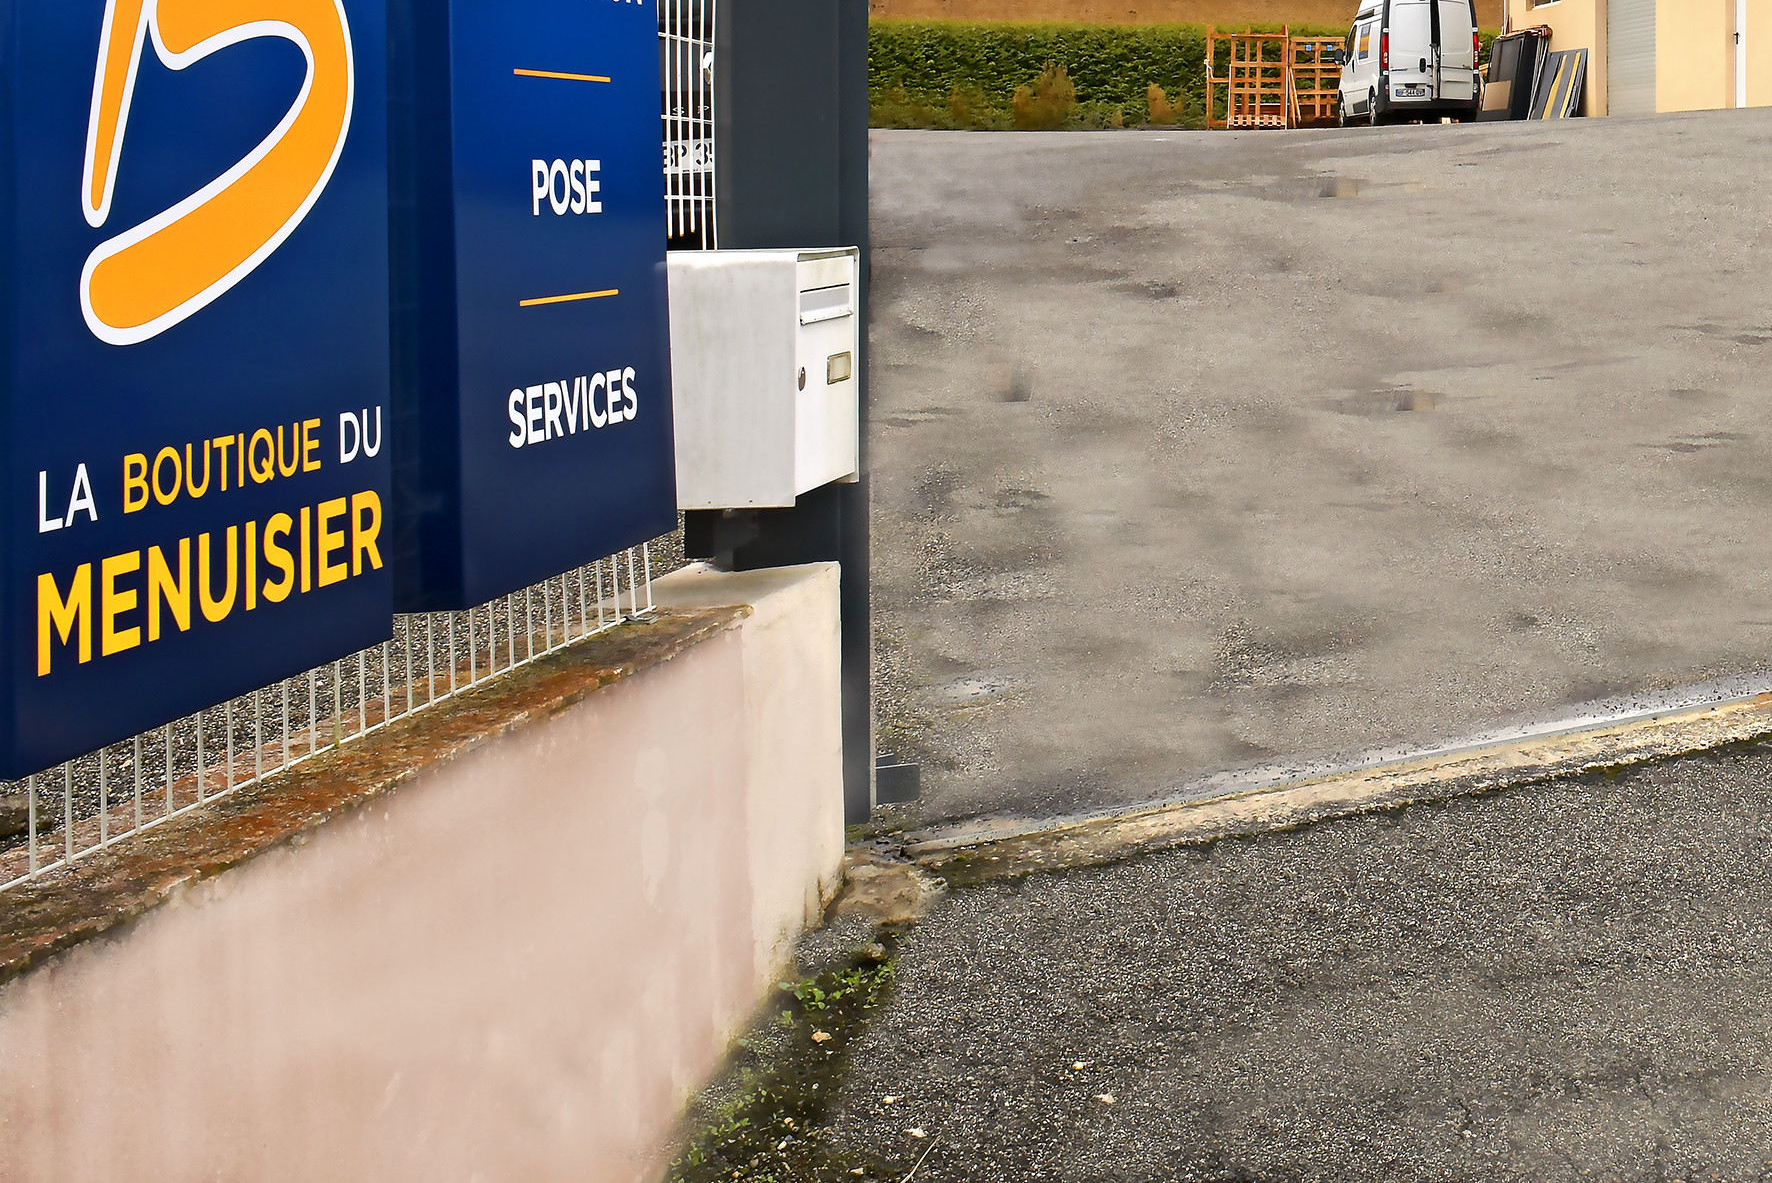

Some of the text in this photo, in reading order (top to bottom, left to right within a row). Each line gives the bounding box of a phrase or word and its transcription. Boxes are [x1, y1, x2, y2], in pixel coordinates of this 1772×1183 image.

[532, 159, 602, 216] POSE
[509, 367, 638, 449] SERVICES
[38, 406, 382, 533] LA BOUTIQUE DU
[38, 490, 384, 677] MENUISIER
